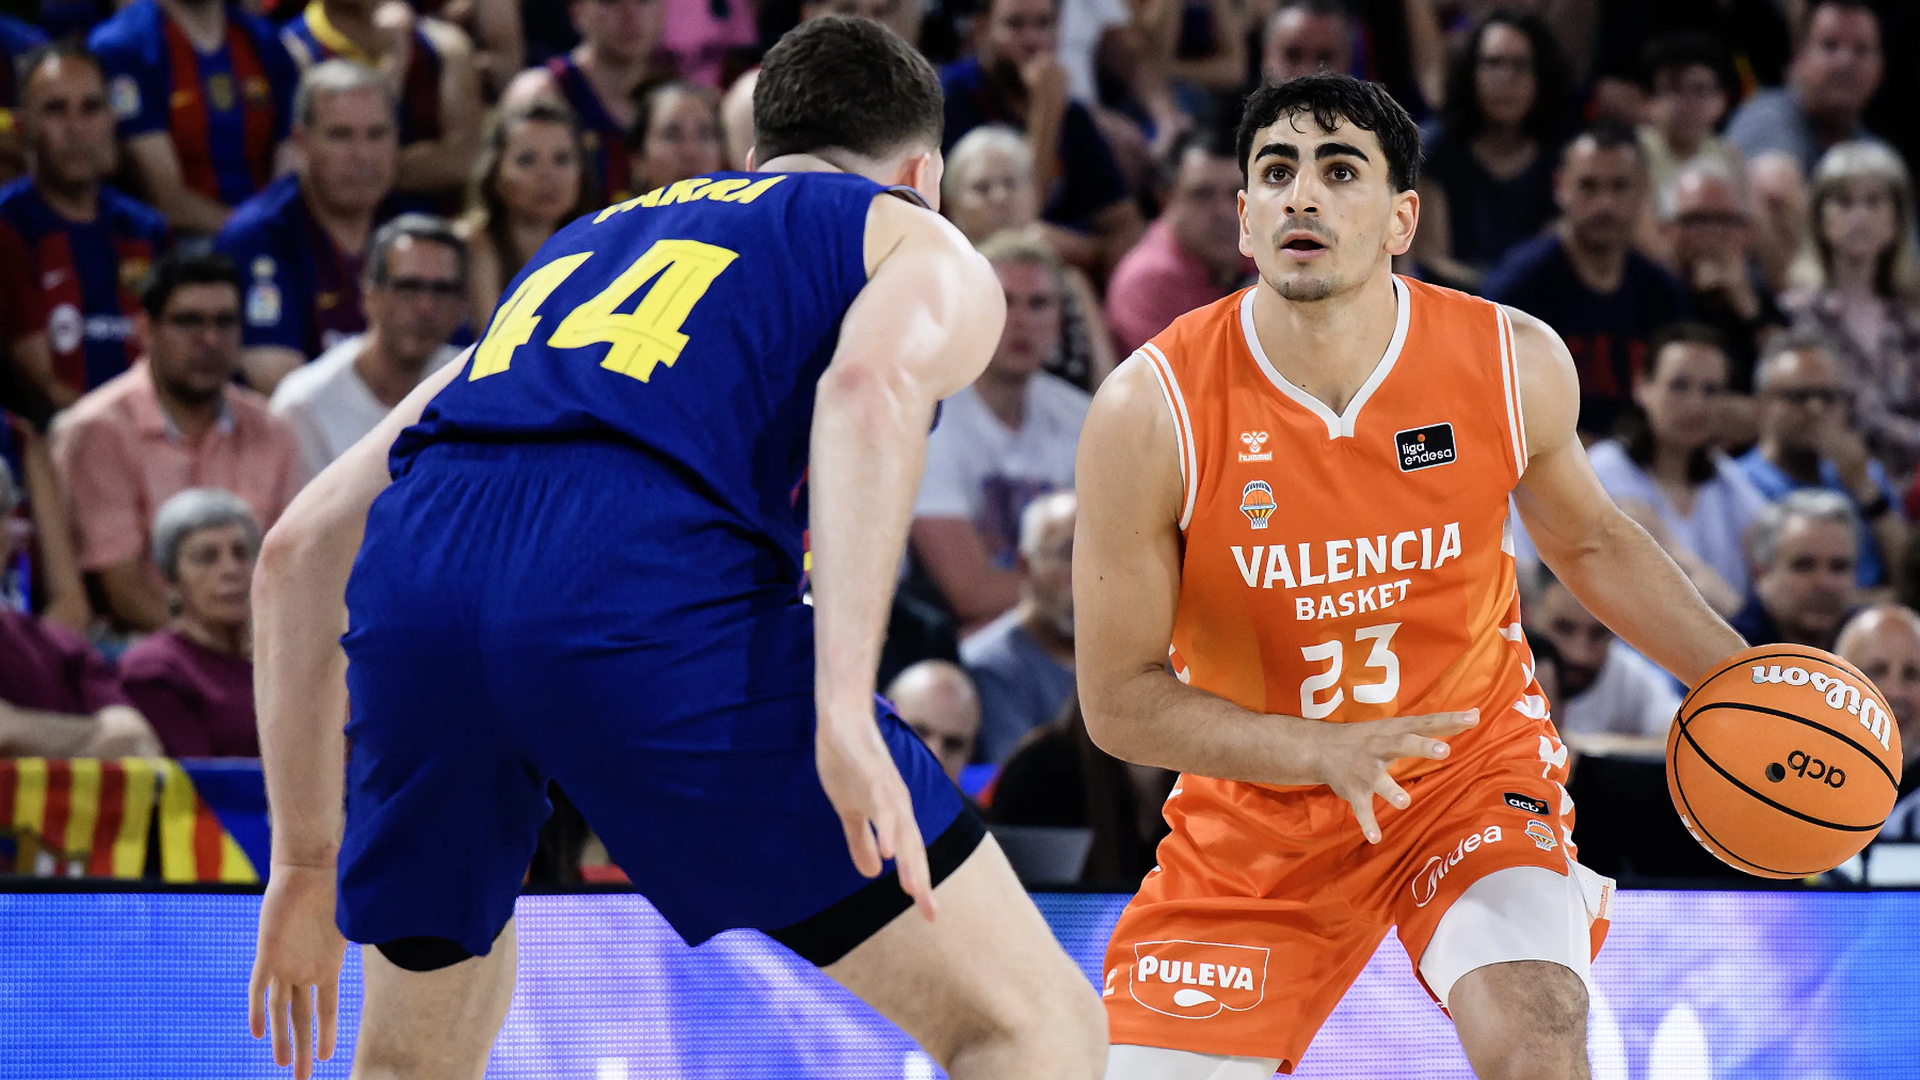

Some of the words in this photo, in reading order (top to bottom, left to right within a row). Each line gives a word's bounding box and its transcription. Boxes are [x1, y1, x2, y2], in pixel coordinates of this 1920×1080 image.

[468, 239, 740, 383] 44
[1238, 451, 1272, 462] hummel
[1402, 442, 1425, 456] liga
[1404, 449, 1453, 466] endesa
[1229, 521, 1462, 589] VALENCIA
[1295, 578, 1412, 621] BASKET
[1300, 622, 1403, 719] 23
[1751, 665, 1891, 752] Wilson
[1787, 750, 1846, 789] acb
[1508, 798, 1540, 813] acb
[1412, 825, 1503, 907] Midea
[1137, 955, 1254, 991] PULEVA
